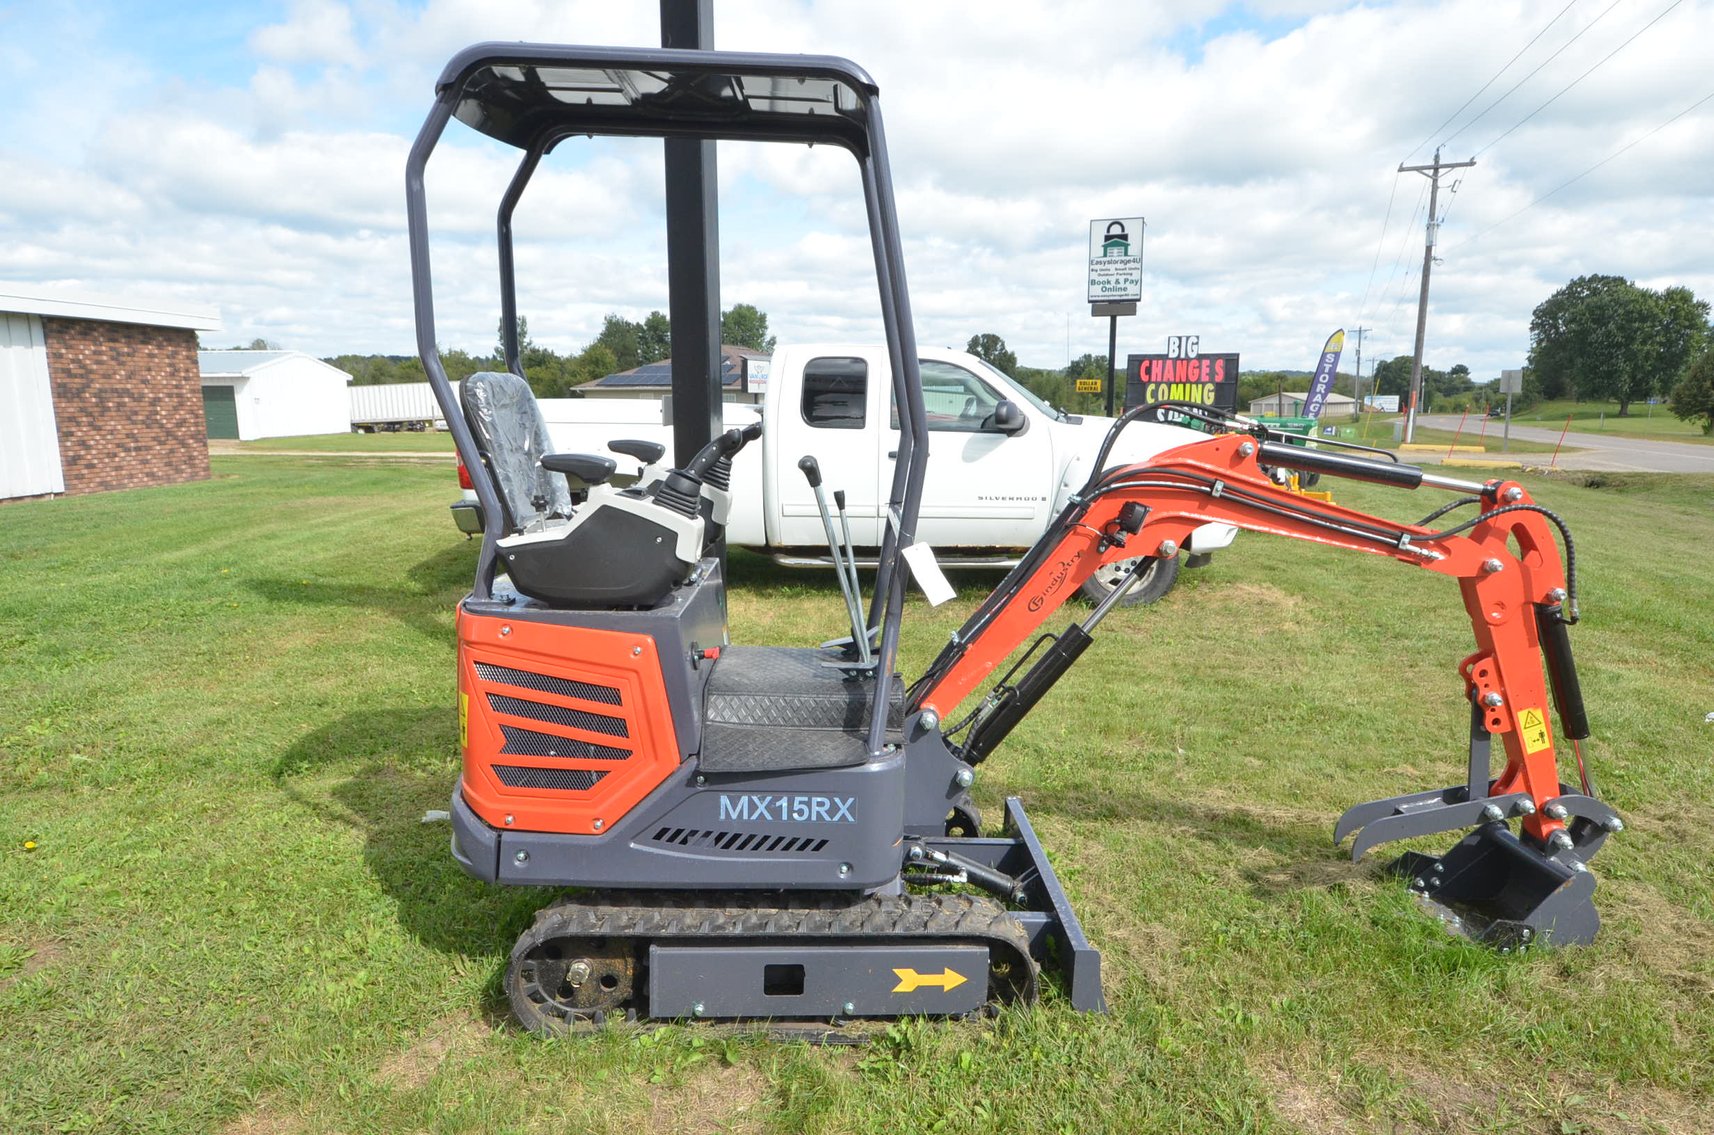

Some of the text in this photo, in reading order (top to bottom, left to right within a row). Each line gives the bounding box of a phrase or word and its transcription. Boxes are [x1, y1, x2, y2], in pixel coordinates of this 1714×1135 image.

[1090, 258, 1141, 266] Easystorage4U
[1124, 278, 1139, 286] Pay
[1168, 336, 1200, 358] BIG
[1146, 383, 1215, 405] COMING
[1308, 353, 1336, 420] STORAGE
[720, 795, 855, 822] MX15RX
